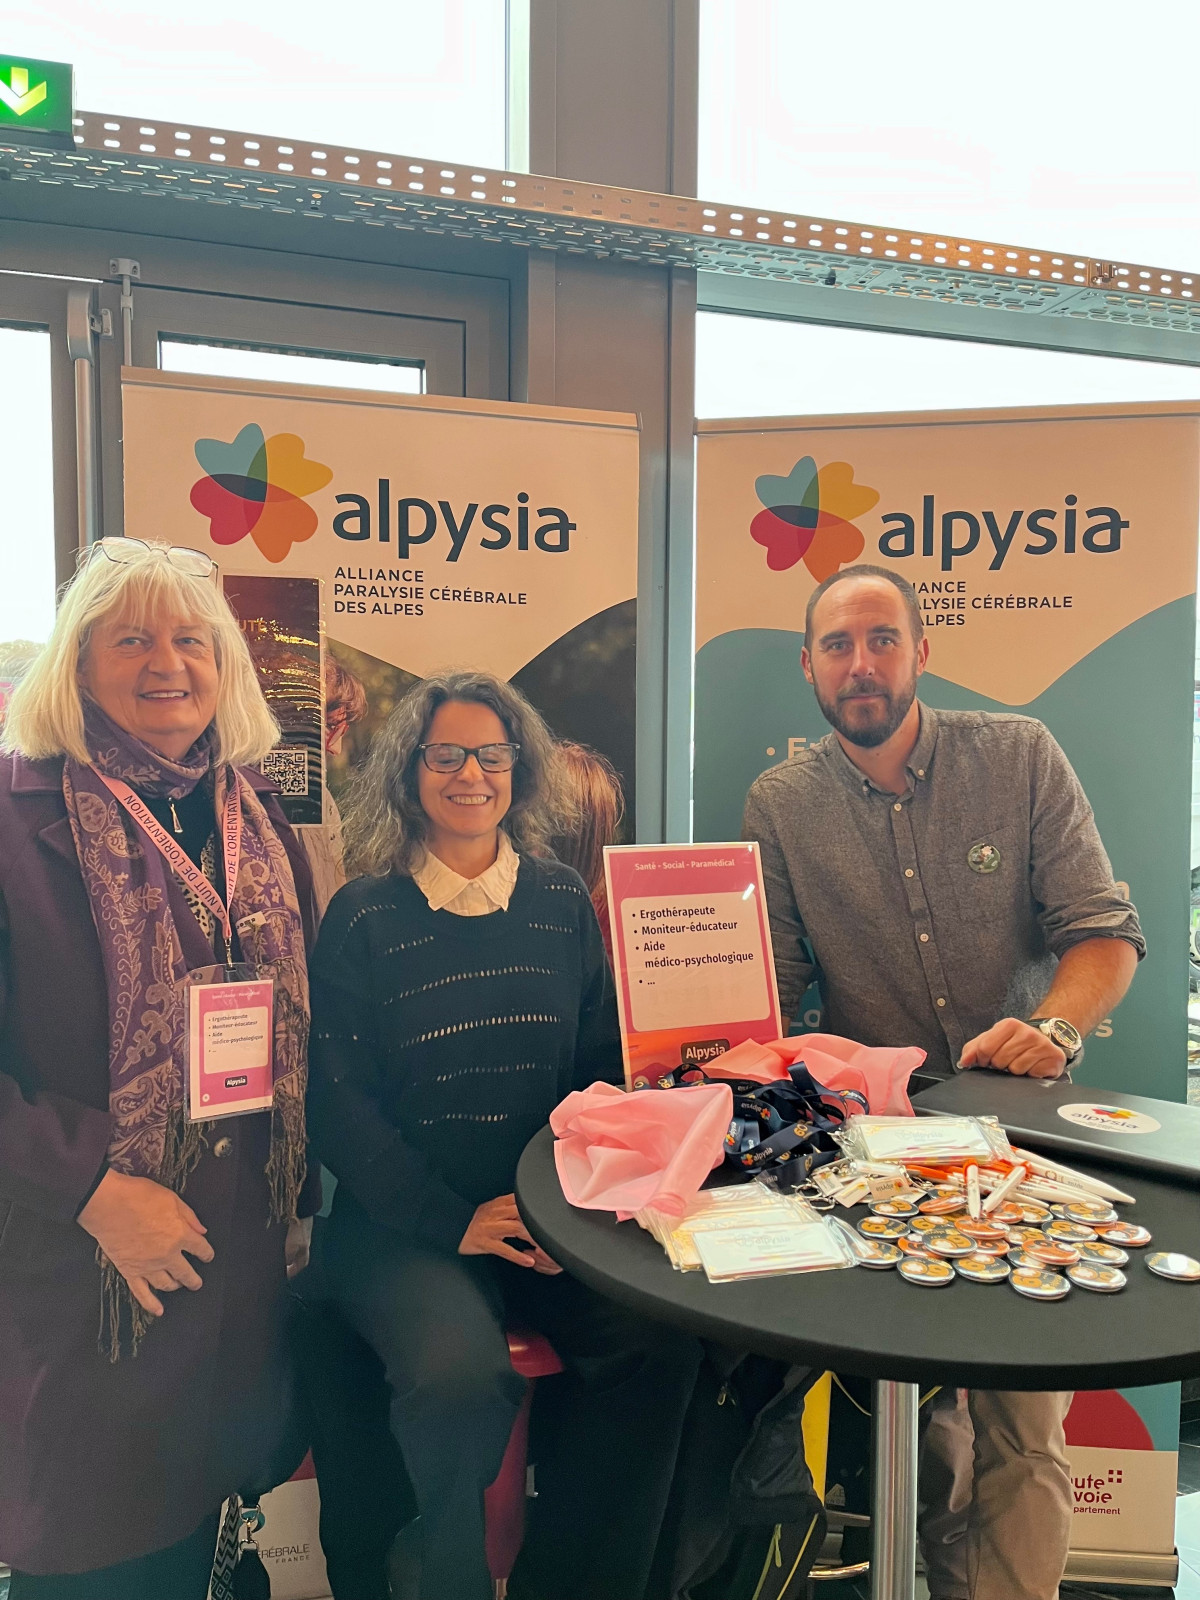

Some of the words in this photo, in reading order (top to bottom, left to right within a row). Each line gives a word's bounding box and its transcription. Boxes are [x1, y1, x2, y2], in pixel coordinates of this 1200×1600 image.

[333, 478, 577, 562] alpysia
[878, 494, 1130, 571] alpysia
[334, 566, 424, 583] ALLIANCE
[334, 583, 424, 600] PARALYSIE
[429, 585, 527, 605] CÉRÉBRALE
[971, 594, 1073, 609] CÉRÉBRALE
[334, 601, 367, 614] DES
[371, 603, 424, 616] ALPES
[123, 795, 185, 867] L'ORIENTATION
[228, 861, 236, 874] DE
[634, 862, 656, 871] Santé
[662, 861, 685, 870] Social
[691, 858, 735, 869] Paramédical
[182, 866, 199, 882] DE
[194, 882, 218, 906] NUIT
[640, 906, 716, 921] Ergothérapeute
[641, 921, 738, 936] Moniteur-éducateur
[643, 940, 666, 952] Aide
[644, 951, 754, 969] médico-psychologique
[685, 1043, 726, 1061] Alpysia
[1071, 1112, 1140, 1129] alpysia
[275, 1554, 310, 1564] FRANCE
